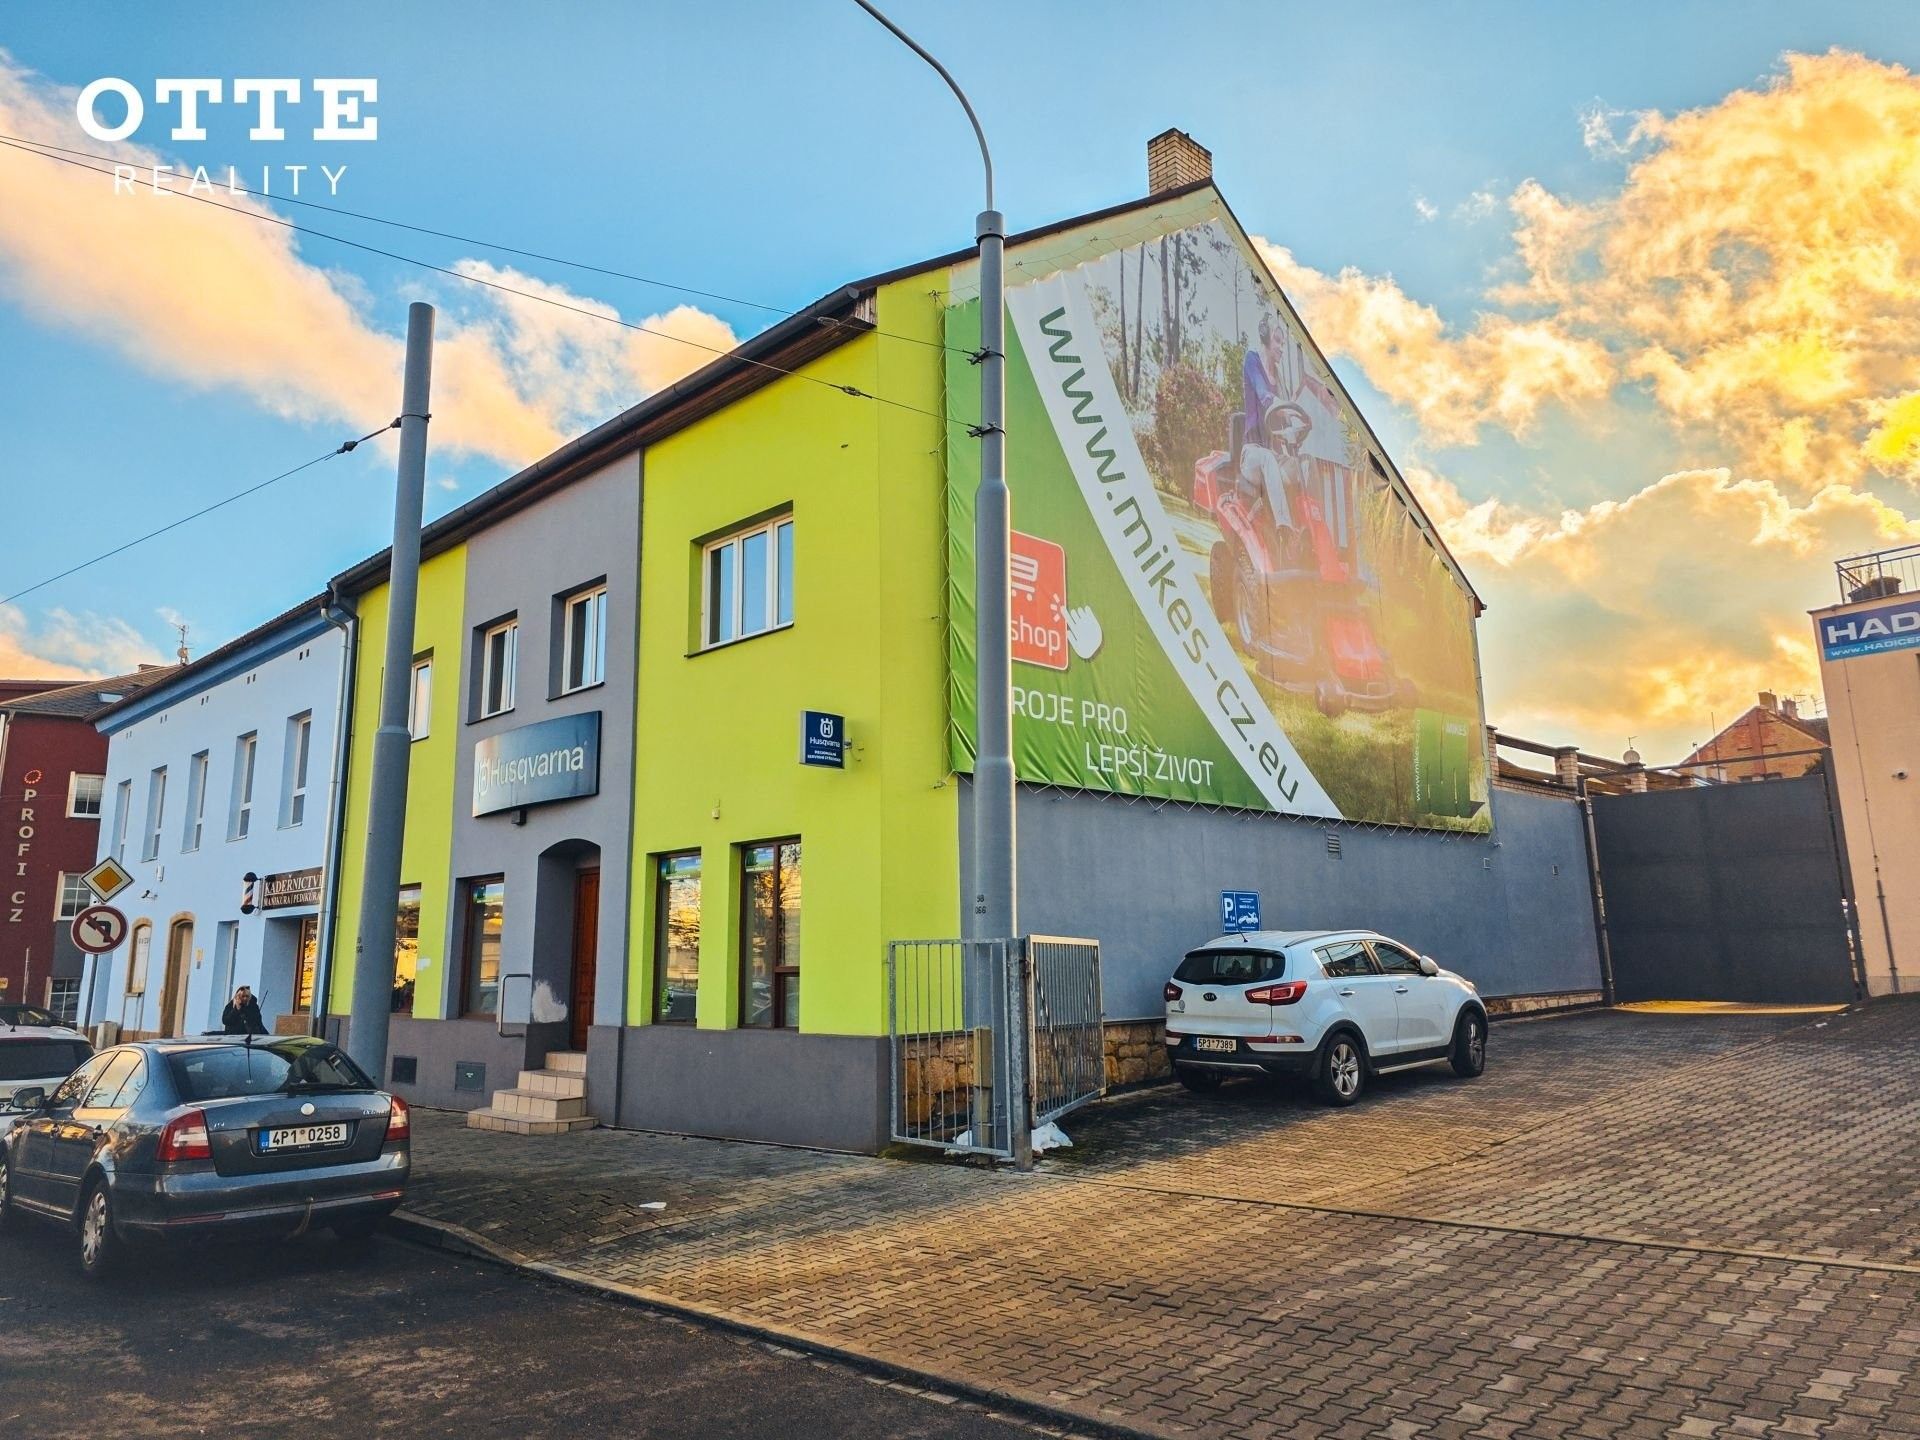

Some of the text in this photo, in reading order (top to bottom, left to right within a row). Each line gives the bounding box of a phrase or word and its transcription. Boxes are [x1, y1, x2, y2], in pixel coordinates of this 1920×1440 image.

[1039, 306, 1299, 803] www.mikes-cz.eu
[1827, 611, 1920, 644] HAD
[1011, 686, 1128, 735] ROJE PRO
[809, 736, 841, 748] Husqvarna
[490, 746, 584, 788] Husqvarna
[1086, 741, 1214, 786] LEPŠÍ ŽIVOT
[9, 788, 37, 922] PROFI CZ
[1223, 897, 1234, 919] P
[1198, 1038, 1234, 1049] 5P3 7389
[272, 1126, 340, 1145] 4P1 0258
